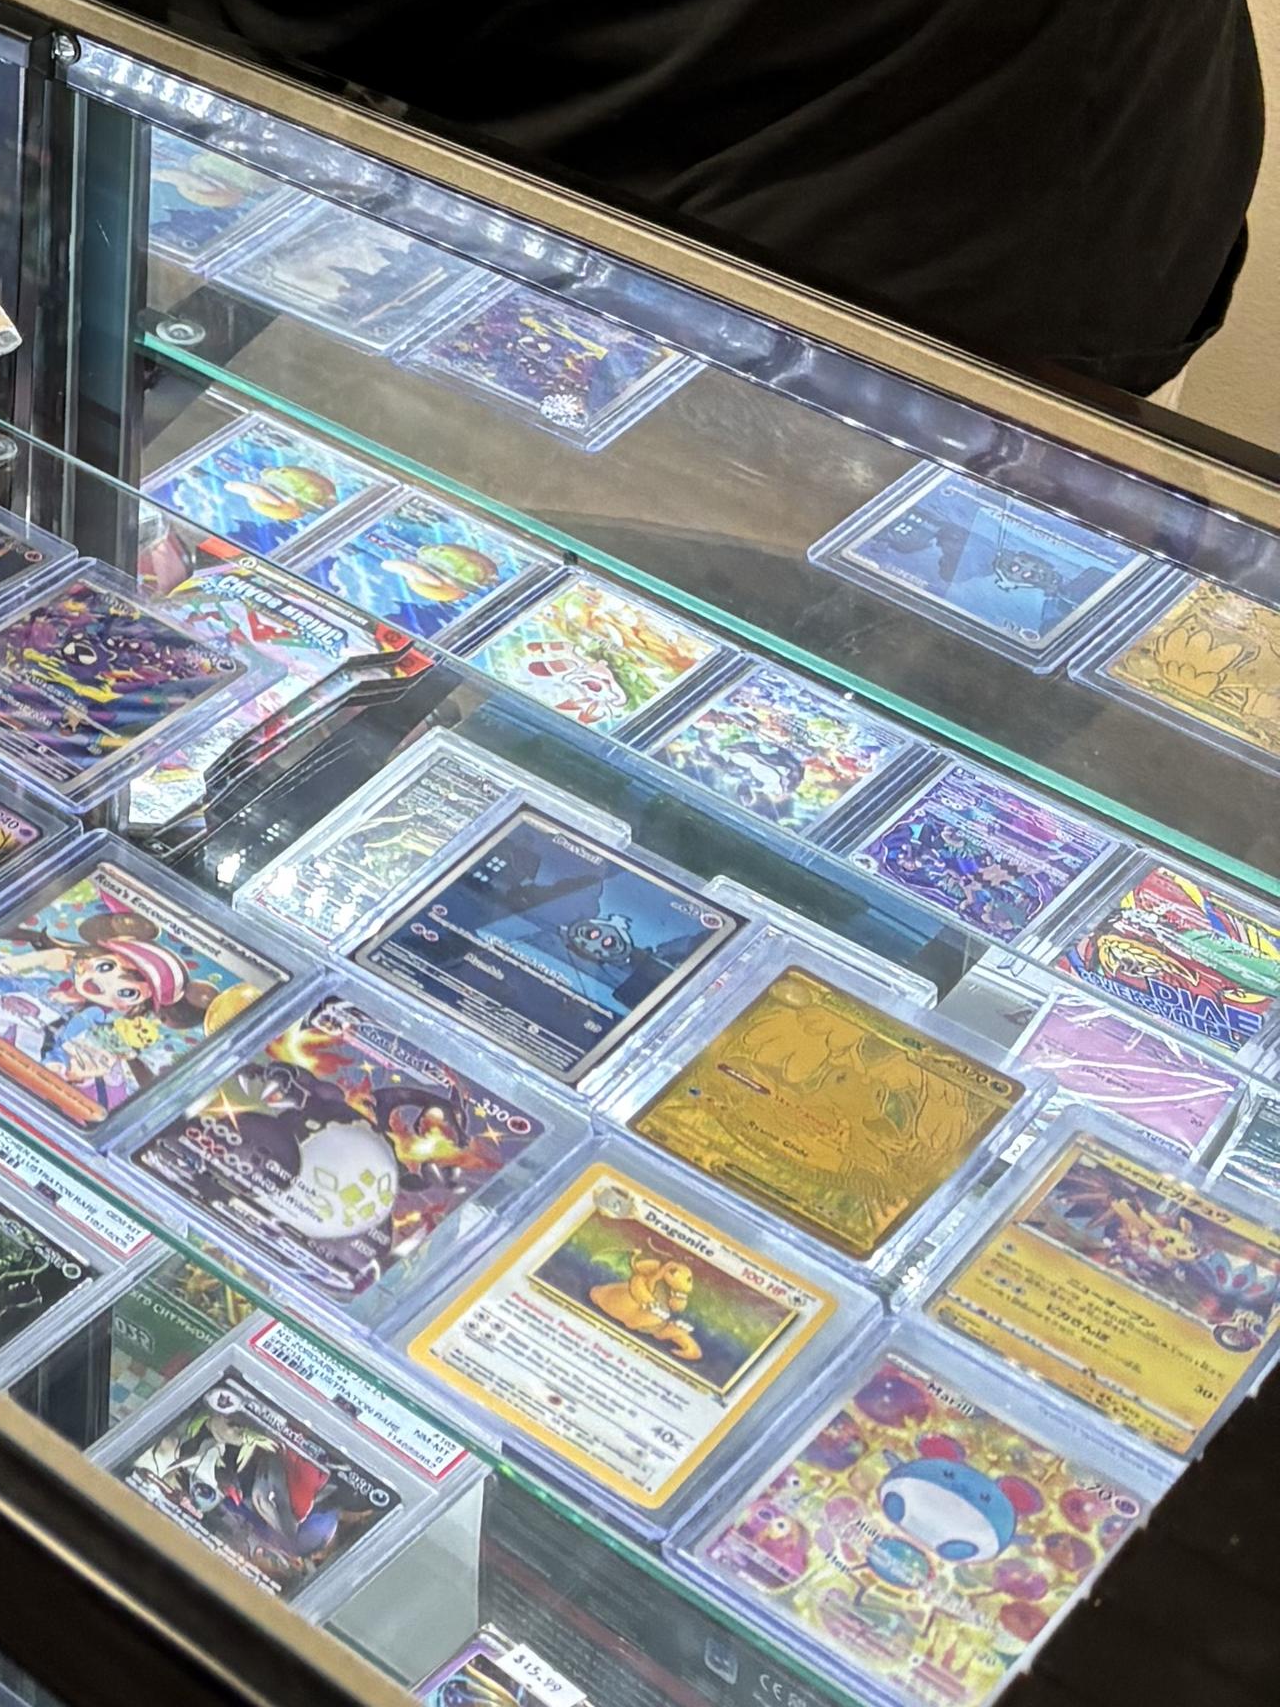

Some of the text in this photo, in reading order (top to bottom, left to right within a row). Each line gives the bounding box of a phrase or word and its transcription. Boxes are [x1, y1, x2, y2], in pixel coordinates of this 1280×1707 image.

[94, 873, 221, 958] Rosa's Encouragement
[478, 1098, 508, 1123] 330
[644, 1210, 715, 1258] Dragonite
[742, 1267, 786, 1297] 100 HP
[927, 1383, 976, 1416] Marill
